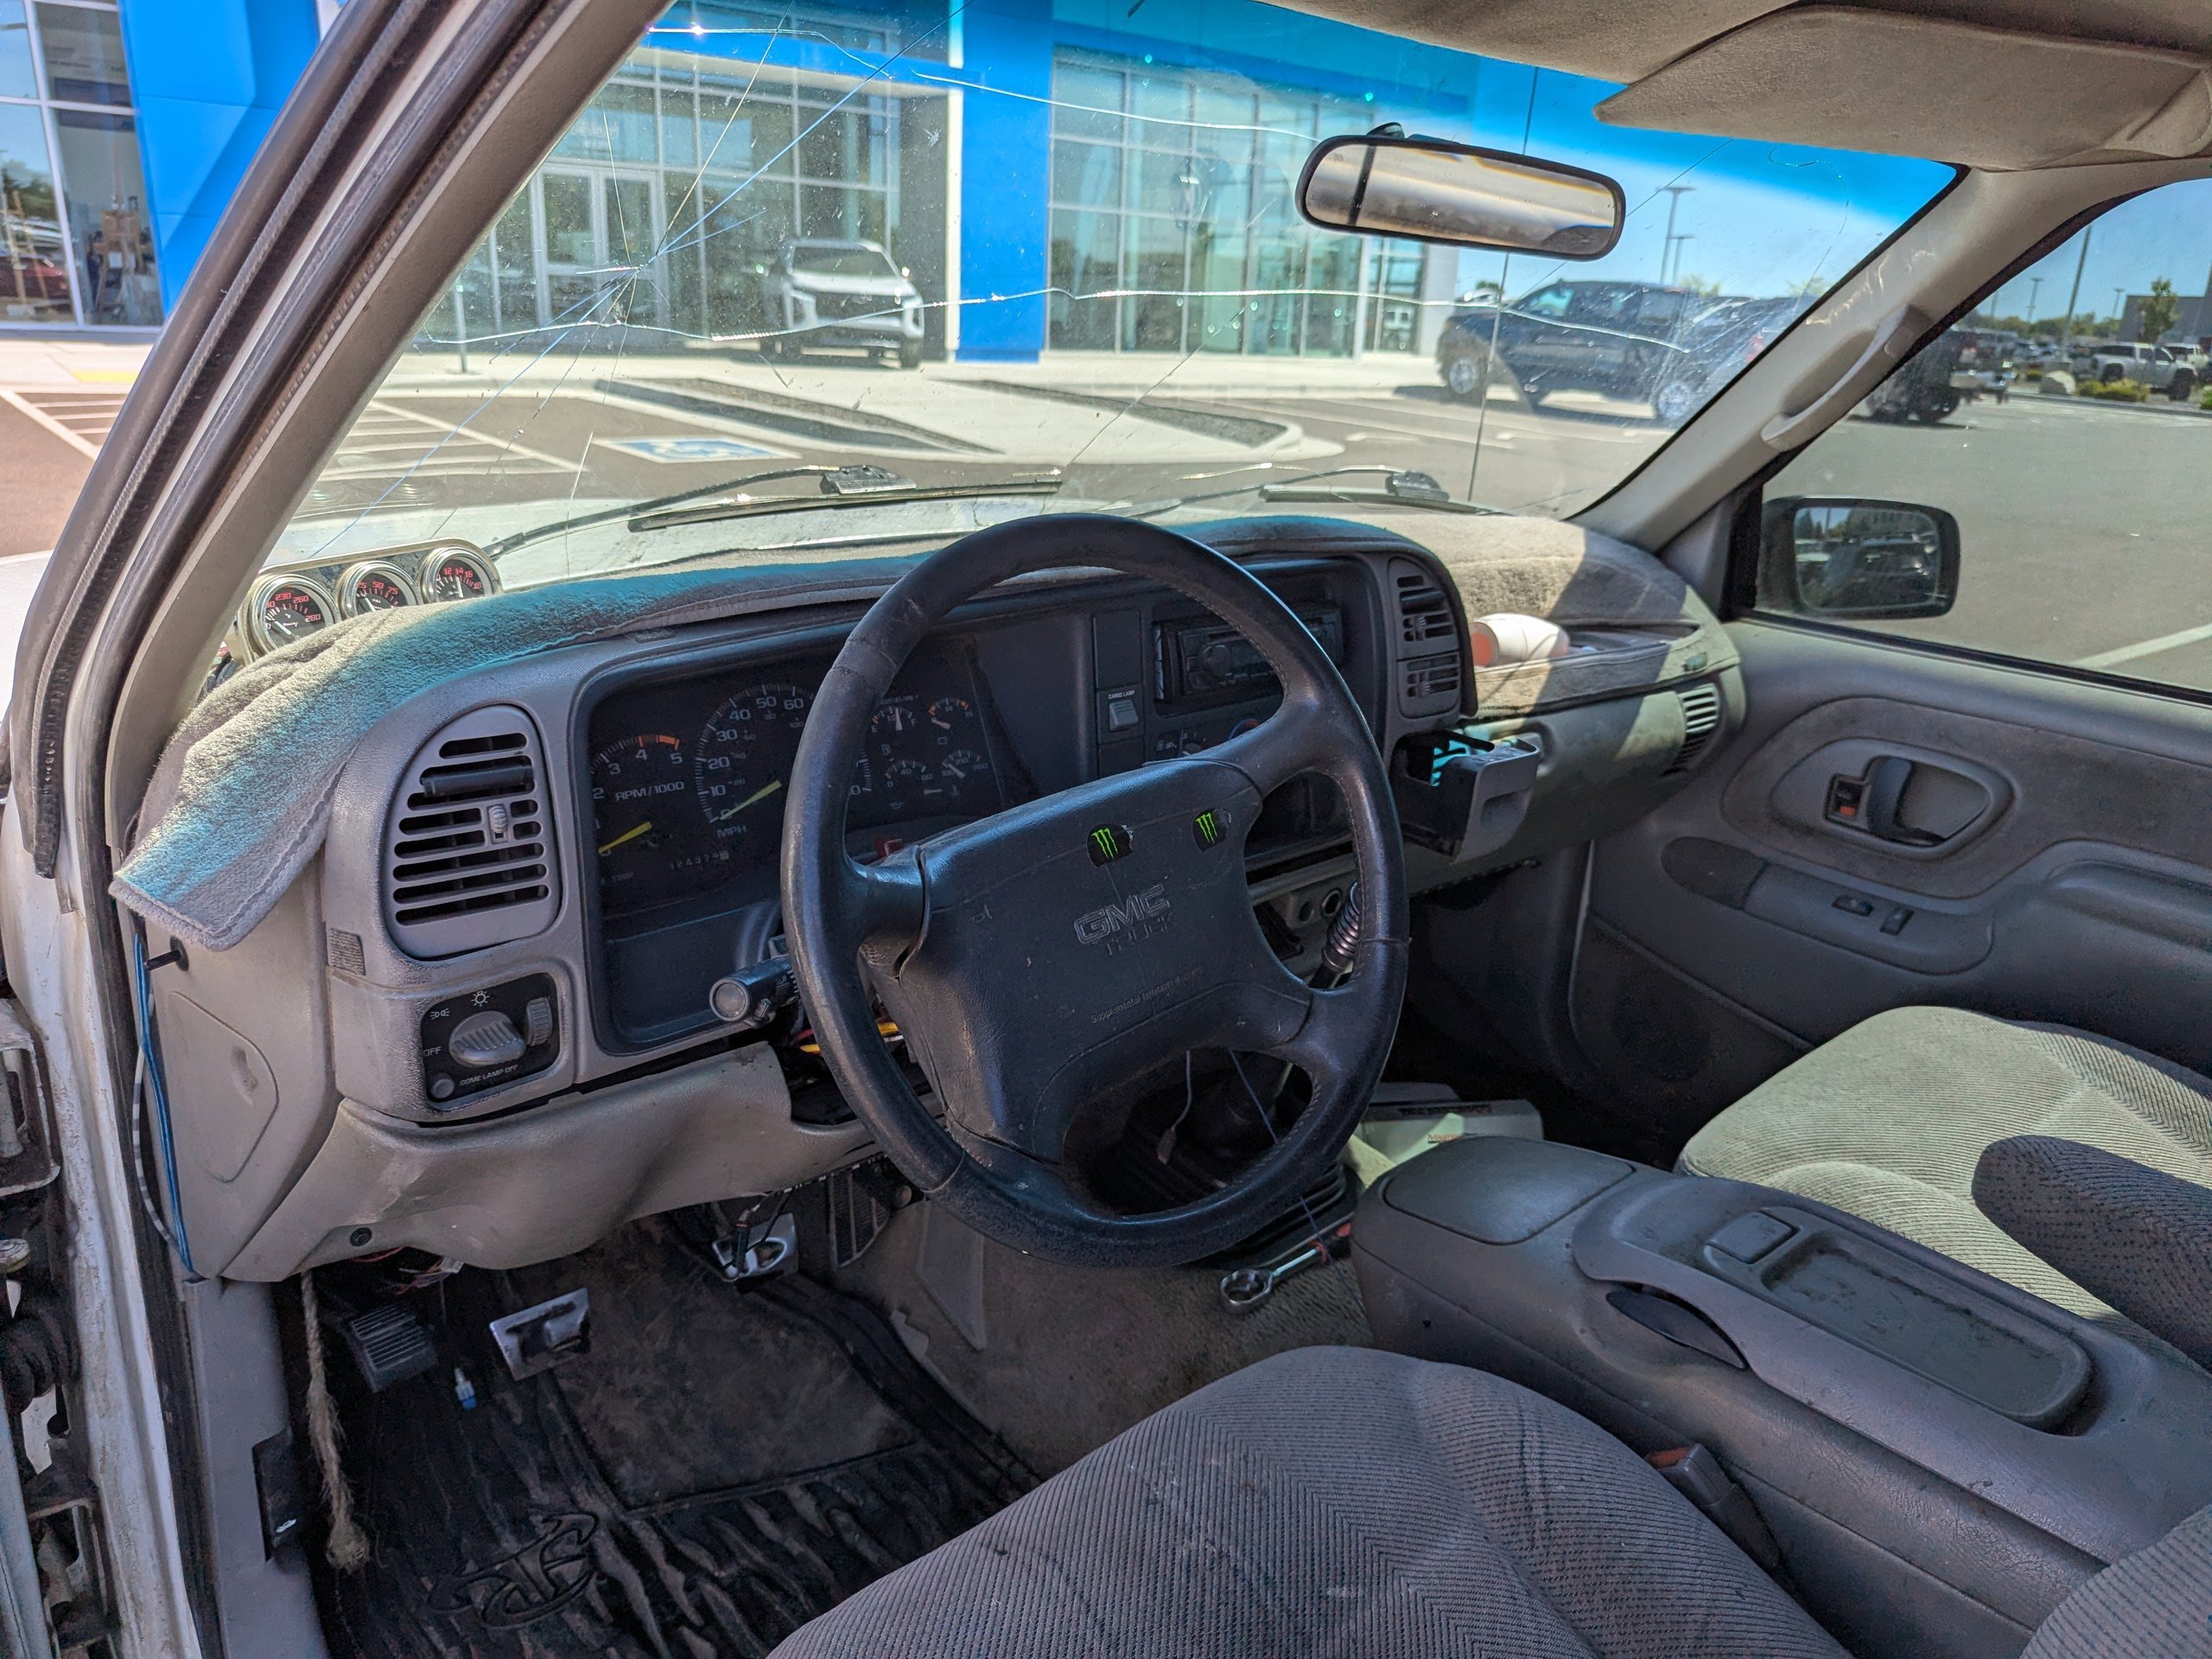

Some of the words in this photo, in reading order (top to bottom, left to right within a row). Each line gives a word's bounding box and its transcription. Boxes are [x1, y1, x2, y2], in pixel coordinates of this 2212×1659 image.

[372, 581, 385, 589] 50
[388, 586, 398, 594] 75
[275, 593, 292, 601] 230
[305, 613, 321, 622] 280
[755, 696, 778, 709] 50
[783, 698, 804, 710] 60
[729, 709, 752, 721] 40
[715, 728, 738, 741] 30
[636, 748, 648, 760] 4
[671, 752, 683, 764] 5
[608, 762, 621, 775] 3
[709, 756, 730, 771] 20
[593, 787, 605, 800] 2
[615, 781, 685, 801] RPM/1000
[709, 785, 726, 797] 10
[716, 824, 747, 838] MPH
[1073, 883, 1171, 944] GMC
[423, 1046, 442, 1057] OFF
[460, 1075, 481, 1086] DOME
[482, 1068, 504, 1080] LAMP
[505, 1065, 518, 1073] OFF
